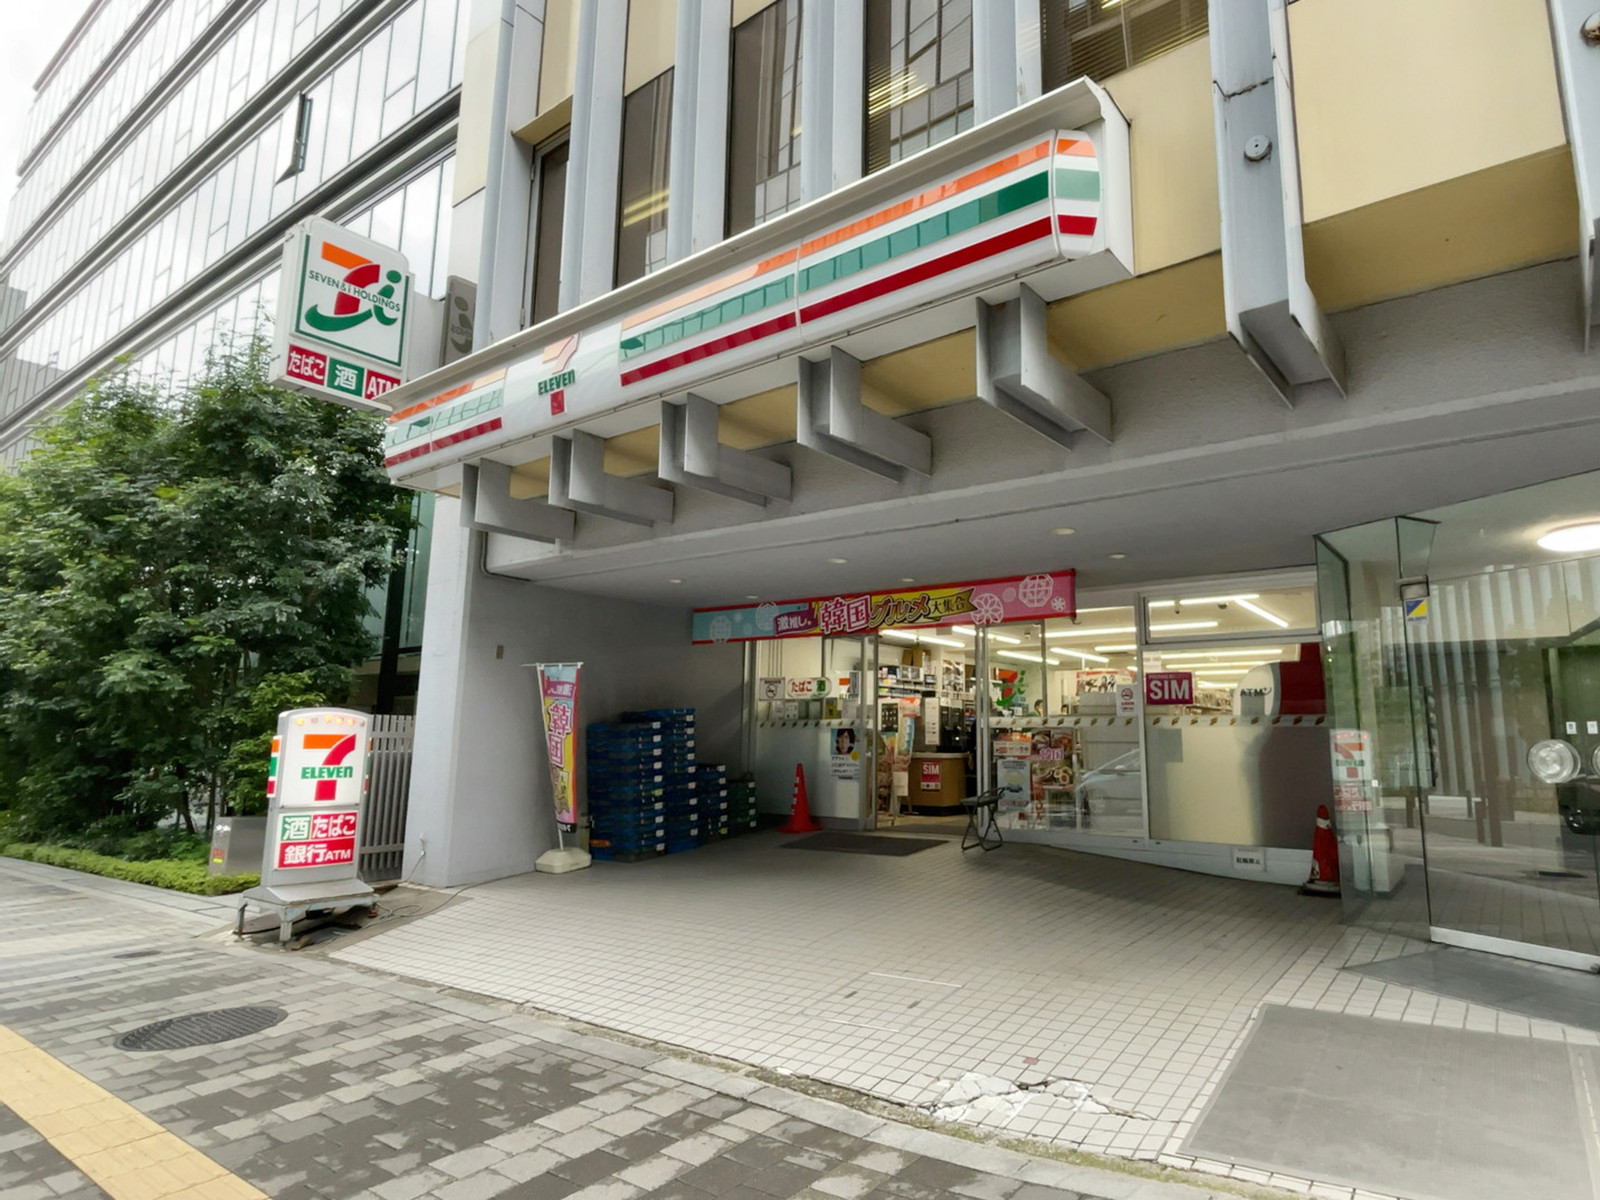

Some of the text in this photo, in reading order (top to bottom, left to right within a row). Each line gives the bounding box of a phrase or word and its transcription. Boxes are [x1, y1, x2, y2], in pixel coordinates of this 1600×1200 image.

[354, 287, 400, 312] HOLDINGS
[288, 350, 325, 380] たばこ
[334, 364, 358, 390] 酒
[791, 681, 812, 692] たばこ
[1149, 679, 1189, 700] SIM
[922, 764, 939, 774] SIM
[282, 814, 356, 840] 酒 たばこ
